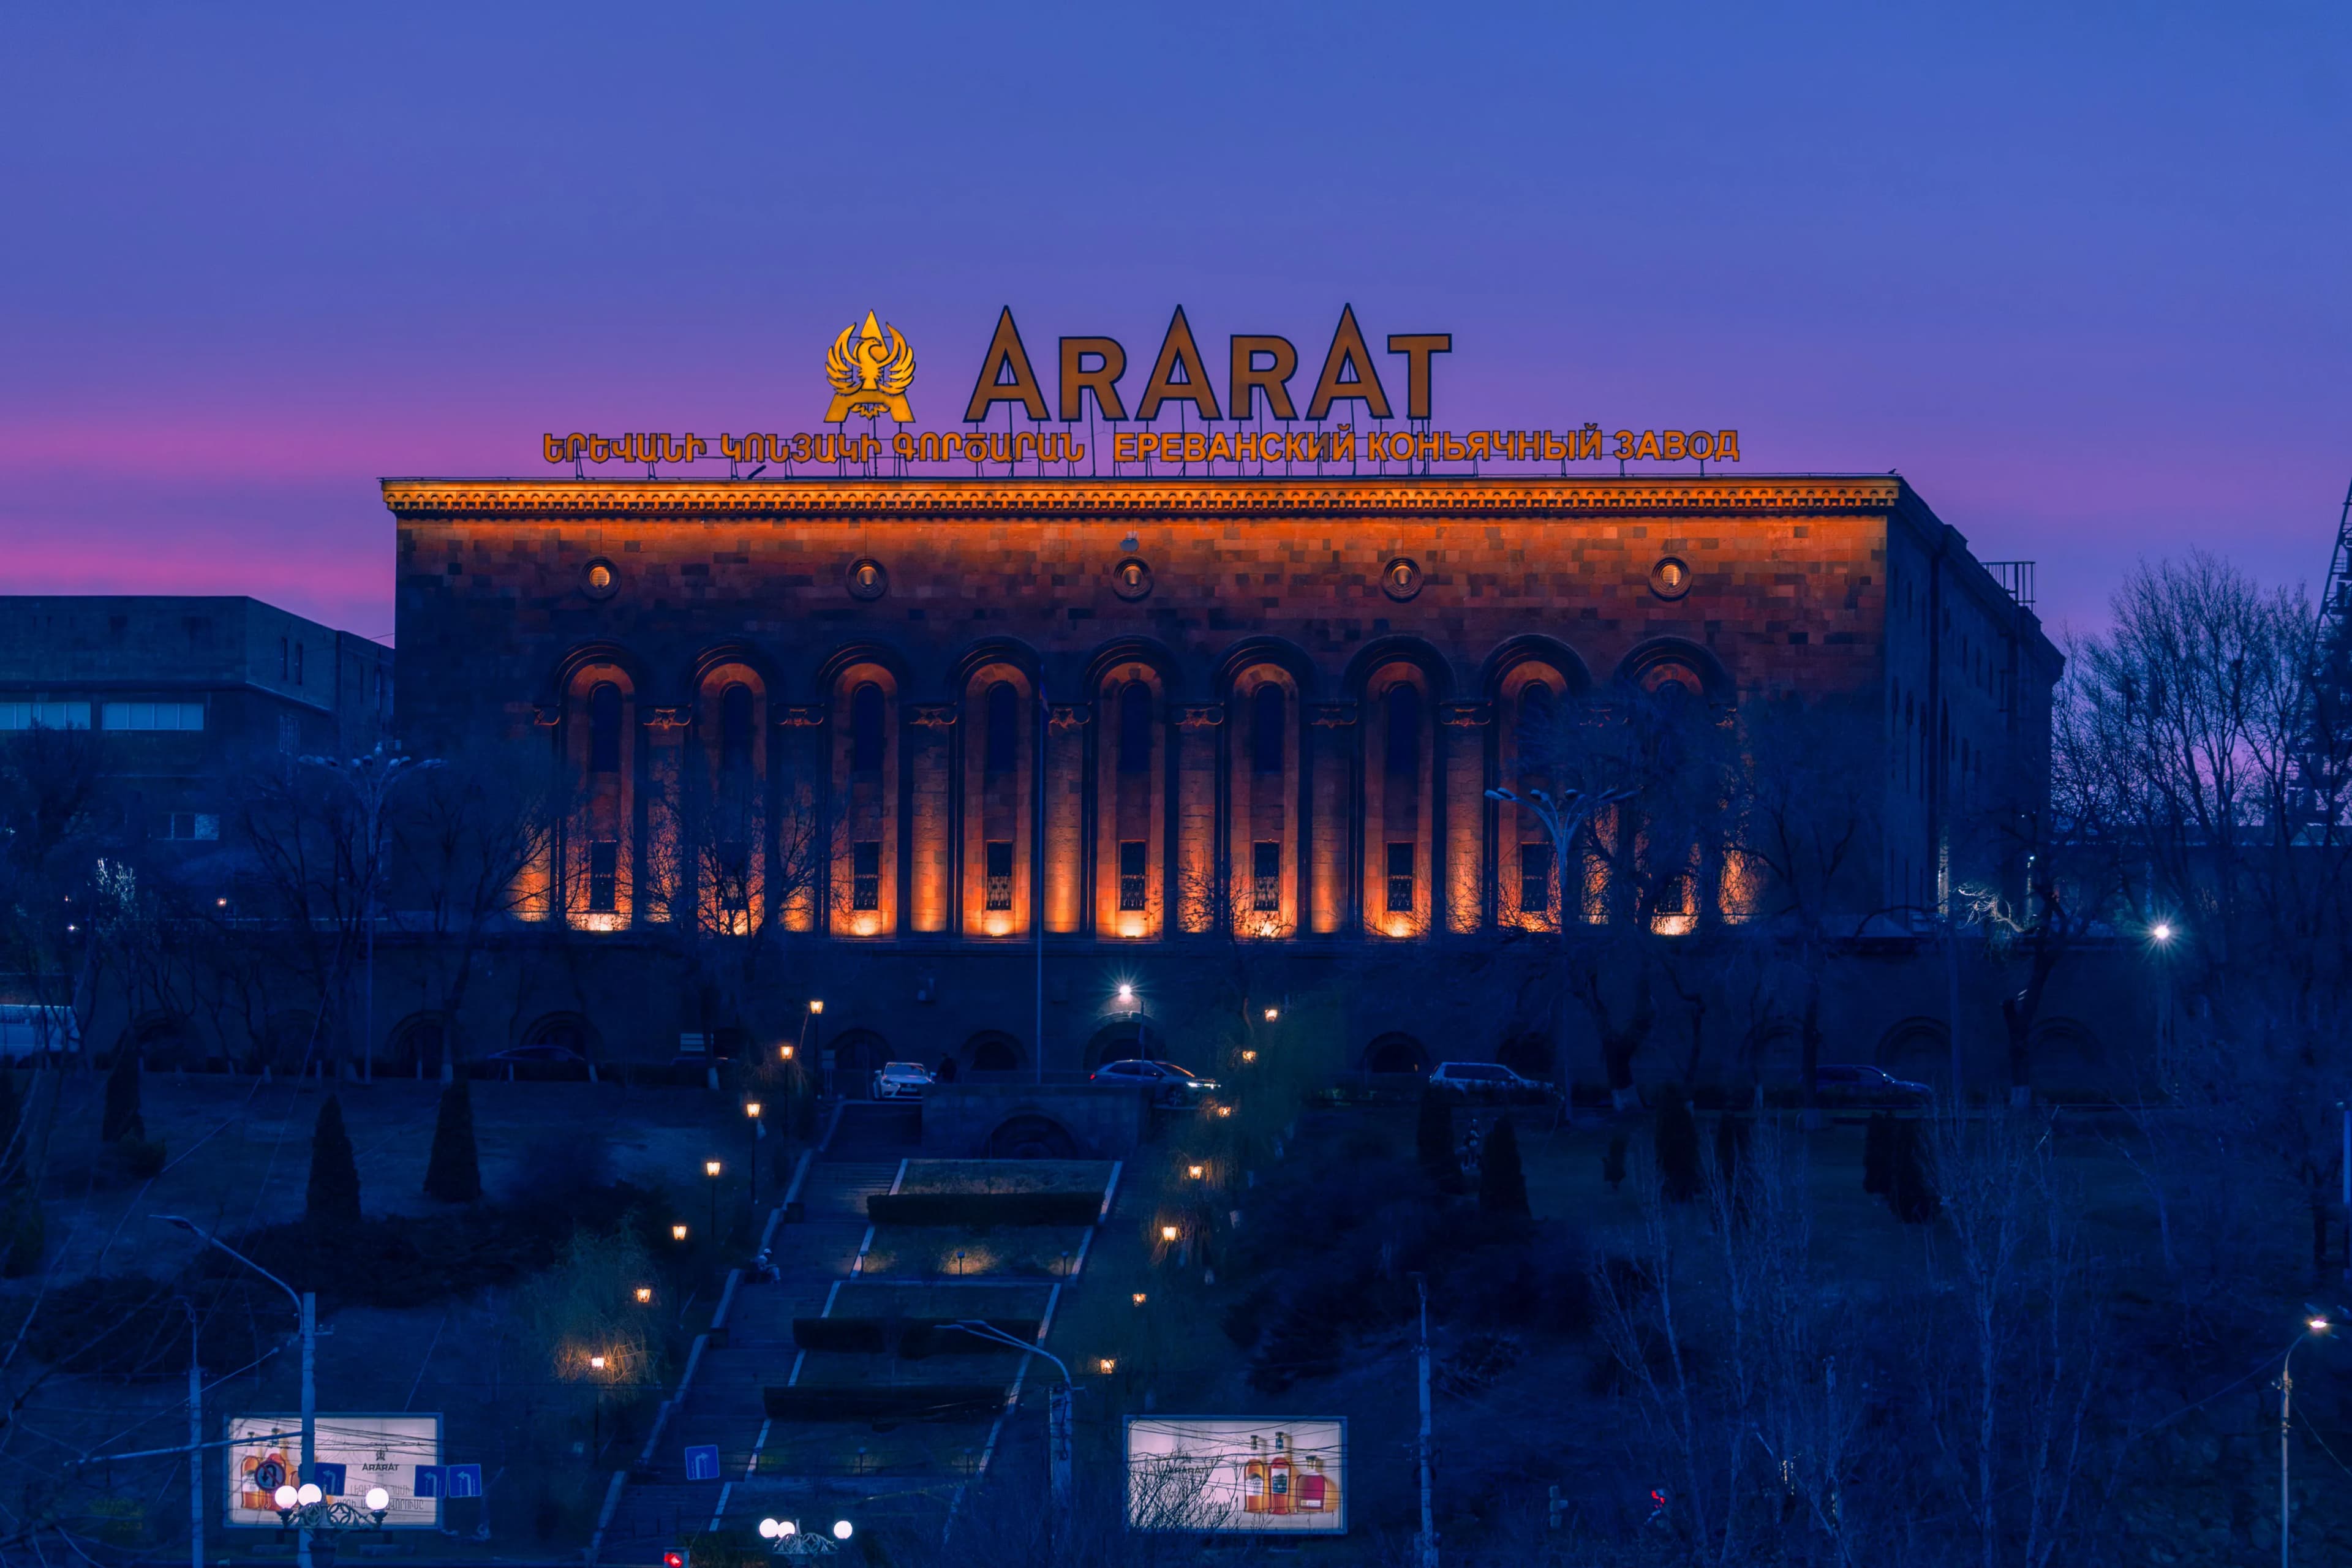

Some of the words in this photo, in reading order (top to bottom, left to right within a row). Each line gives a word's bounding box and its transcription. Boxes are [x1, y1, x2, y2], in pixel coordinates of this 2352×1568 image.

[963, 303, 1452, 421] ARARAT
[543, 432, 707, 464] ԵՐԵՎԱՆԻ
[720, 432, 881, 464] ԿՈՆՅԱԿԻ
[892, 431, 1085, 463] ԳՈՐԾԱՐԱՆ
[1114, 423, 1355, 462] ЕРЕВАНСКИЙ
[1368, 423, 1602, 462] КОНЬЯЧНЫЙ
[1613, 430, 1740, 462] ЗАВОД
